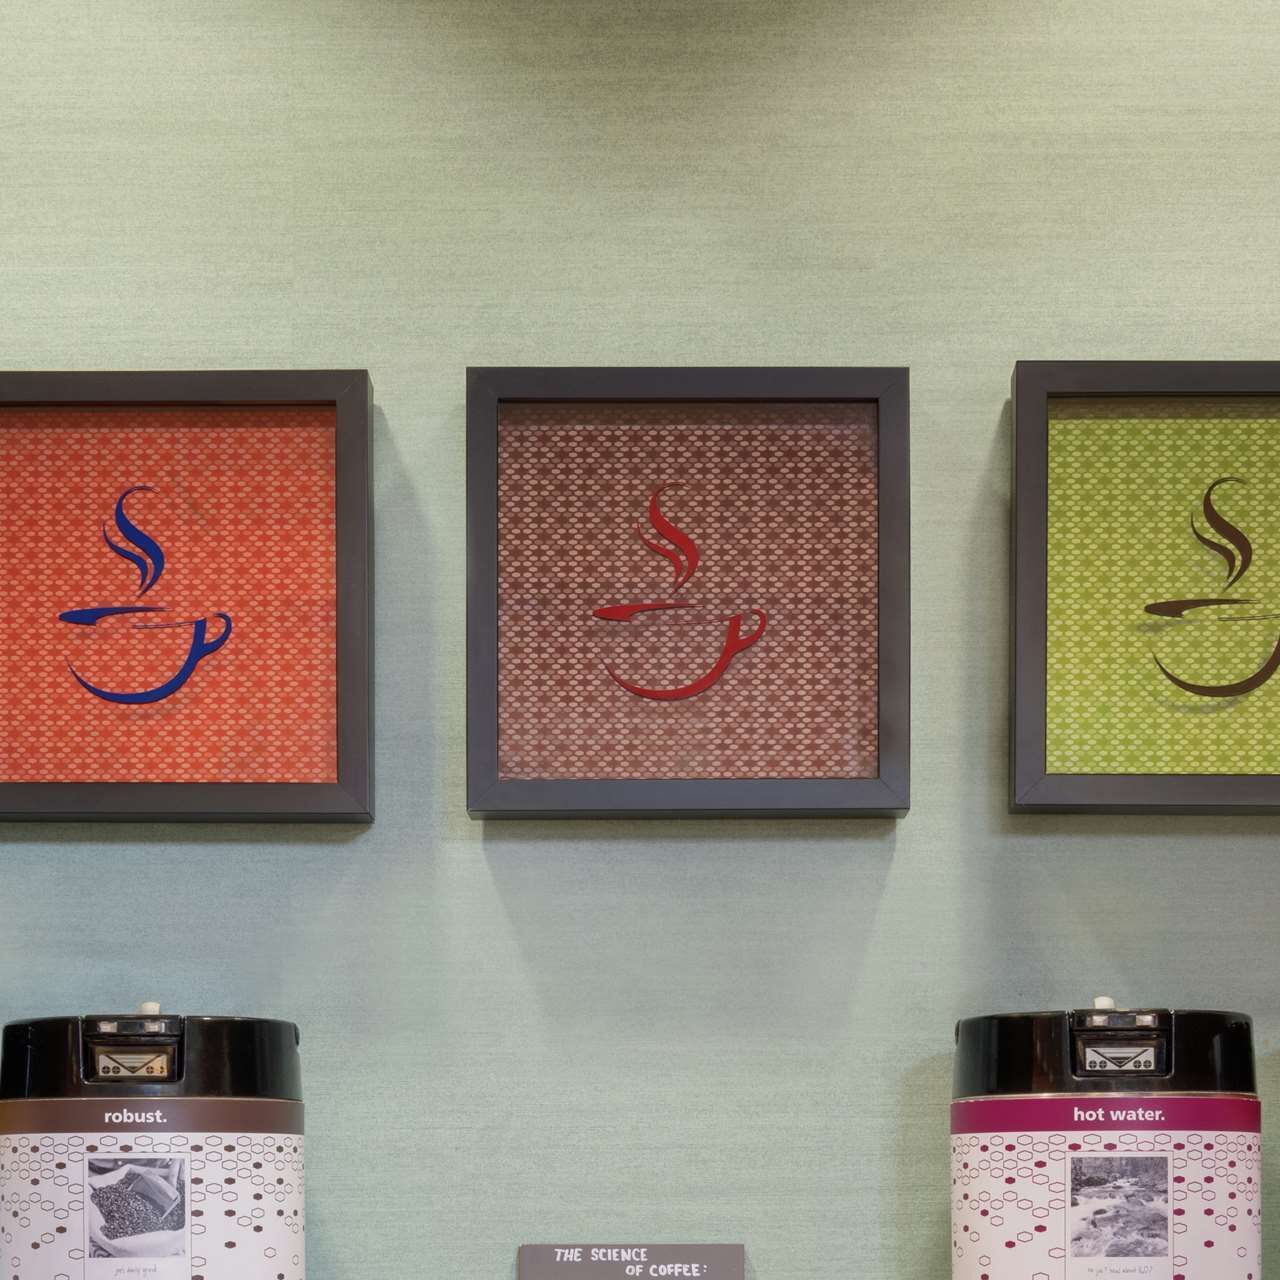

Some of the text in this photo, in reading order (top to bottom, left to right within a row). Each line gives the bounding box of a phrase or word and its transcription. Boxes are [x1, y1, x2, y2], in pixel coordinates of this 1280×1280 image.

[104, 1108, 168, 1123] robust.
[1073, 1107, 1165, 1121] hot water.
[554, 1248, 648, 1262] THE SCIENCE
[625, 1264, 643, 1277] OF
